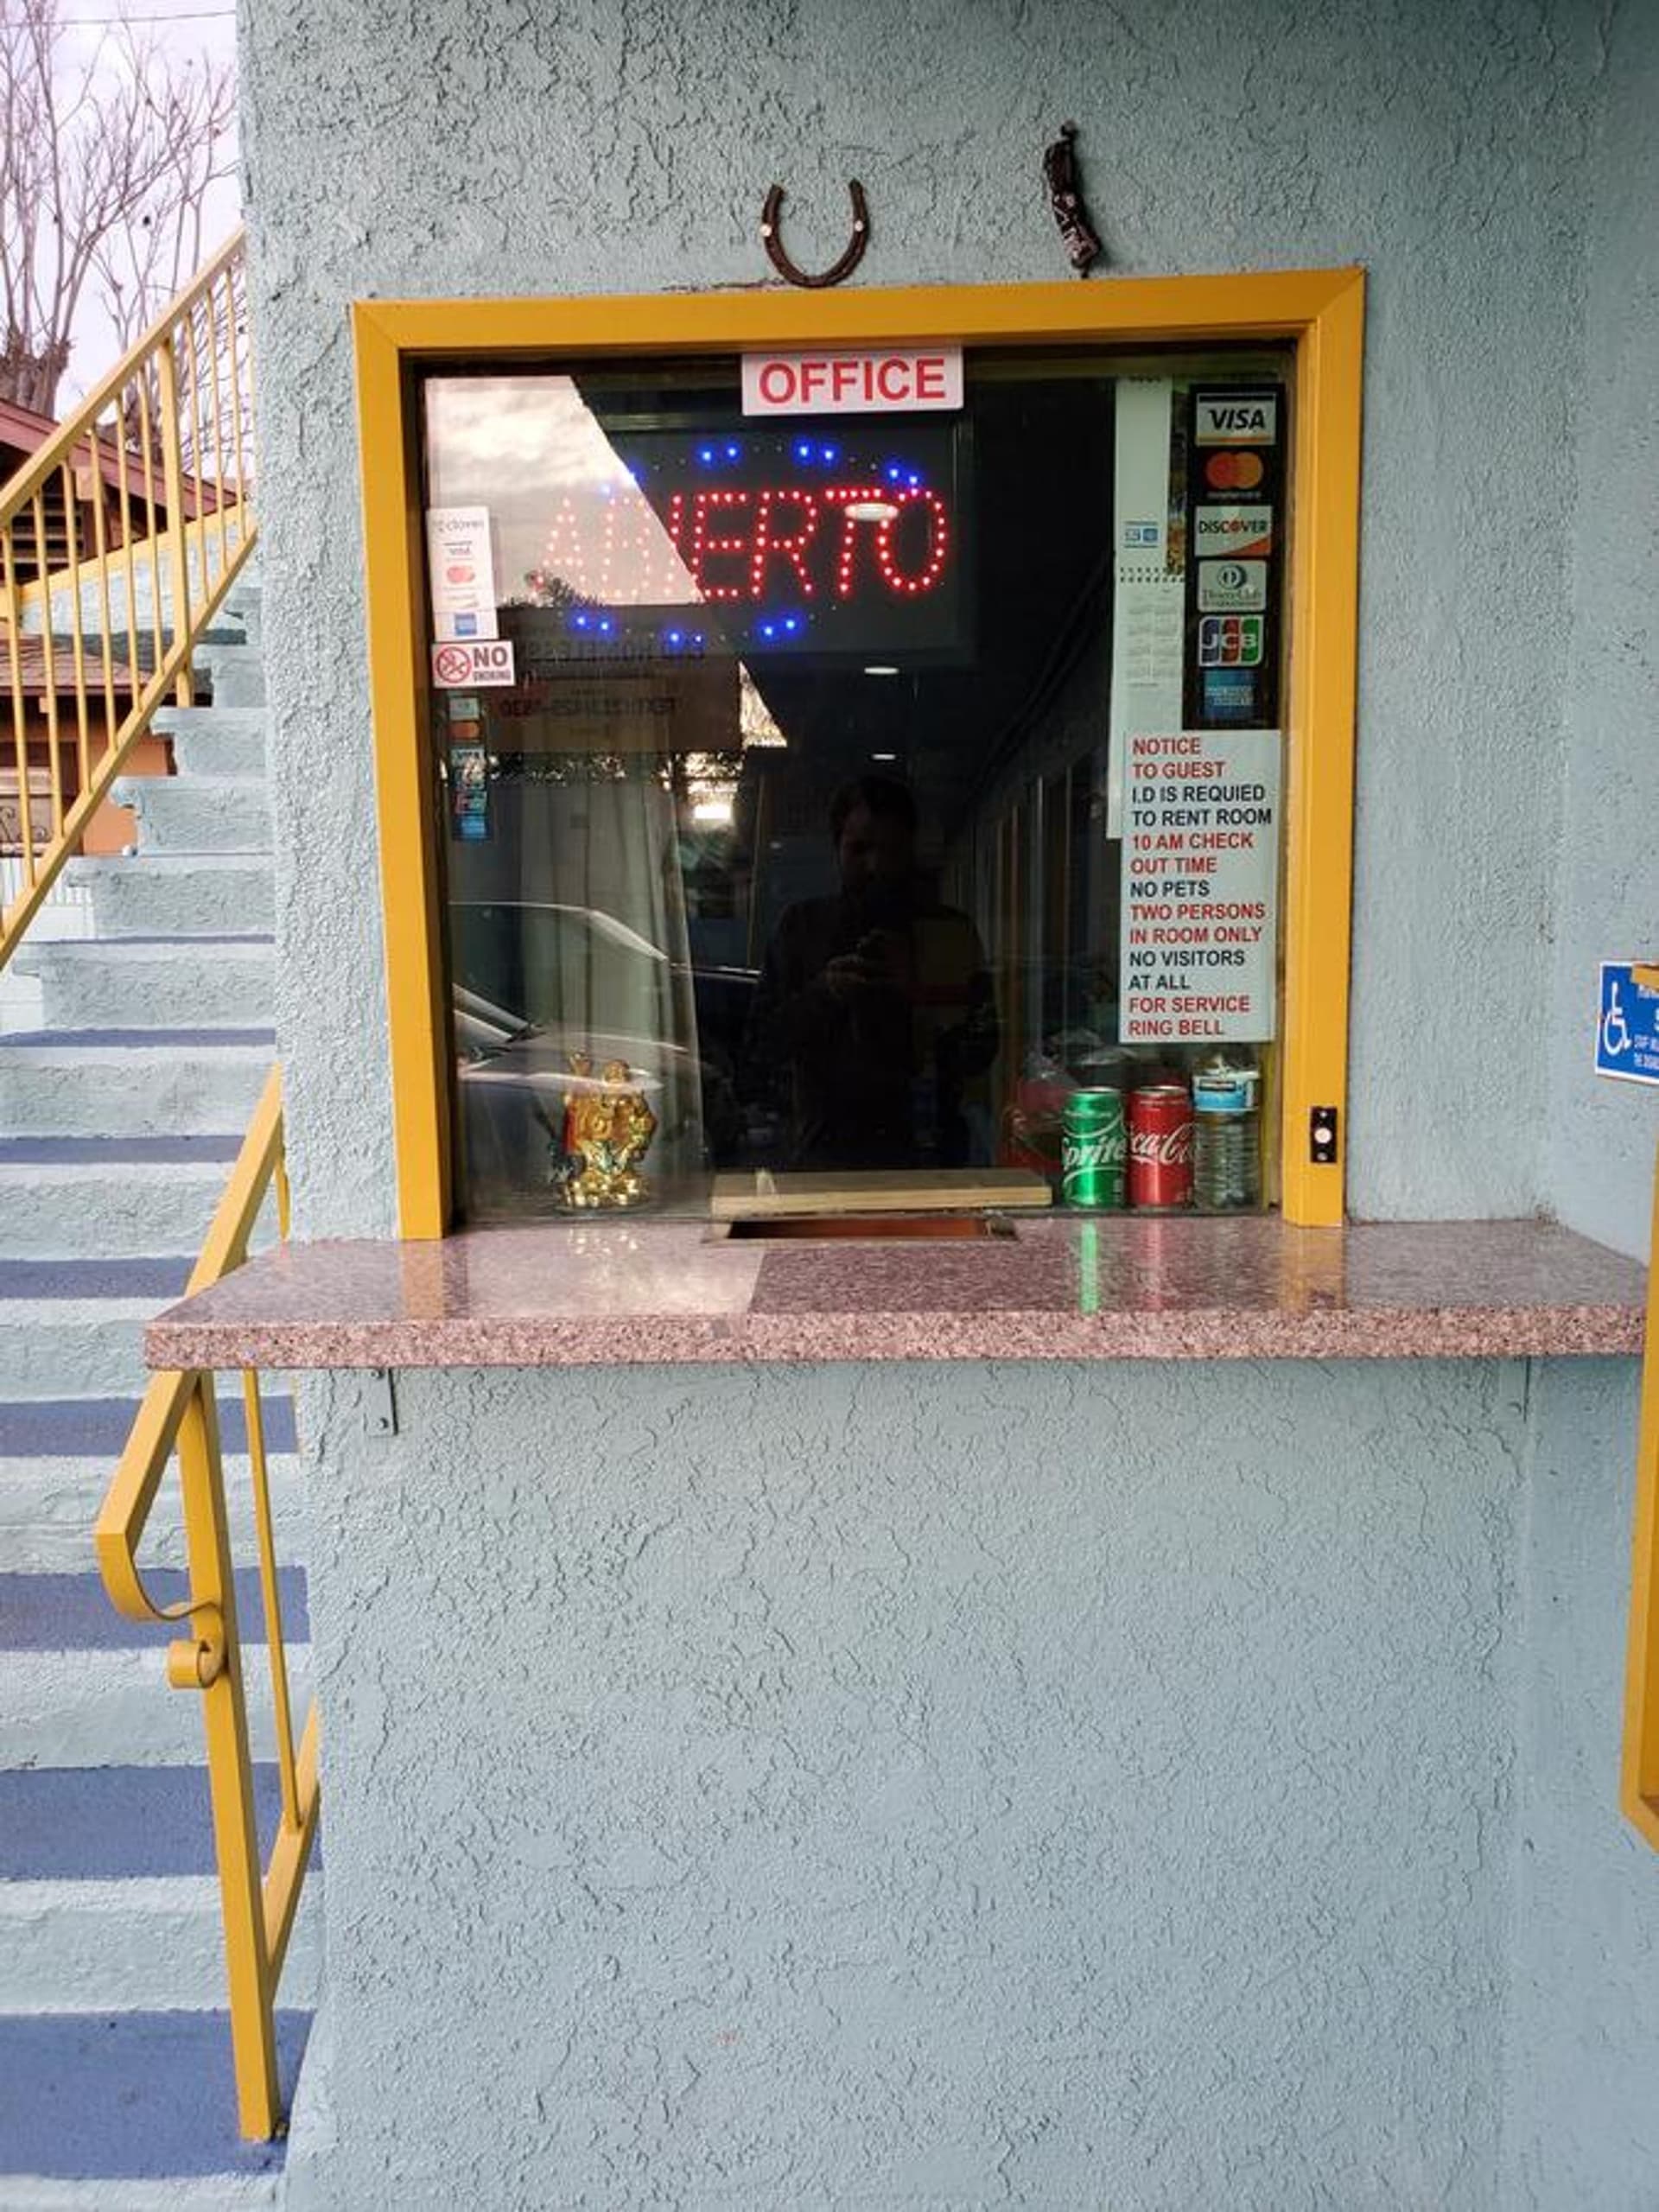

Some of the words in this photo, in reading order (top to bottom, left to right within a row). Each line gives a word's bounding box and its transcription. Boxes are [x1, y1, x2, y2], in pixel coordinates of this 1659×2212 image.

[760, 358, 945, 404] OFFICE
[1208, 408, 1266, 431] VISA
[1198, 519, 1268, 534] DISCOVER
[531, 486, 947, 599] ABIERTO
[1202, 632, 1257, 650] JCB
[474, 646, 508, 667] NO
[1132, 737, 1201, 756] NOTICE
[1133, 762, 1157, 779] TO
[1162, 760, 1226, 779] GUEST
[1132, 785, 1156, 804] I.D
[1160, 785, 1178, 803] IS
[1182, 783, 1266, 802] REQUIED
[1133, 810, 1157, 827] TO
[1161, 809, 1211, 826] RENT
[1216, 807, 1272, 825] ROOM
[1132, 835, 1152, 851] 10
[1155, 834, 1183, 851] AM
[1188, 832, 1254, 849] CHECK
[1130, 857, 1166, 875] OUT
[1174, 856, 1217, 874] TIME
[1129, 881, 1158, 899] NO
[1162, 880, 1211, 898] PETS
[1129, 904, 1172, 921] TWO
[1177, 902, 1266, 920] PERSONS
[1129, 927, 1147, 944] IN
[1153, 927, 1209, 944] ROOM
[1213, 925, 1262, 944] ONLY
[1128, 950, 1156, 968] NO
[1161, 949, 1245, 967] VISITORS
[1128, 974, 1151, 991] AT
[1155, 974, 1192, 990] ALL
[1128, 997, 1166, 1014] FOR
[1171, 995, 1250, 1013] SERVICE
[1128, 1019, 1173, 1037] RING
[1178, 1019, 1224, 1036] BELL
[1063, 1135, 1126, 1171] Sprite
